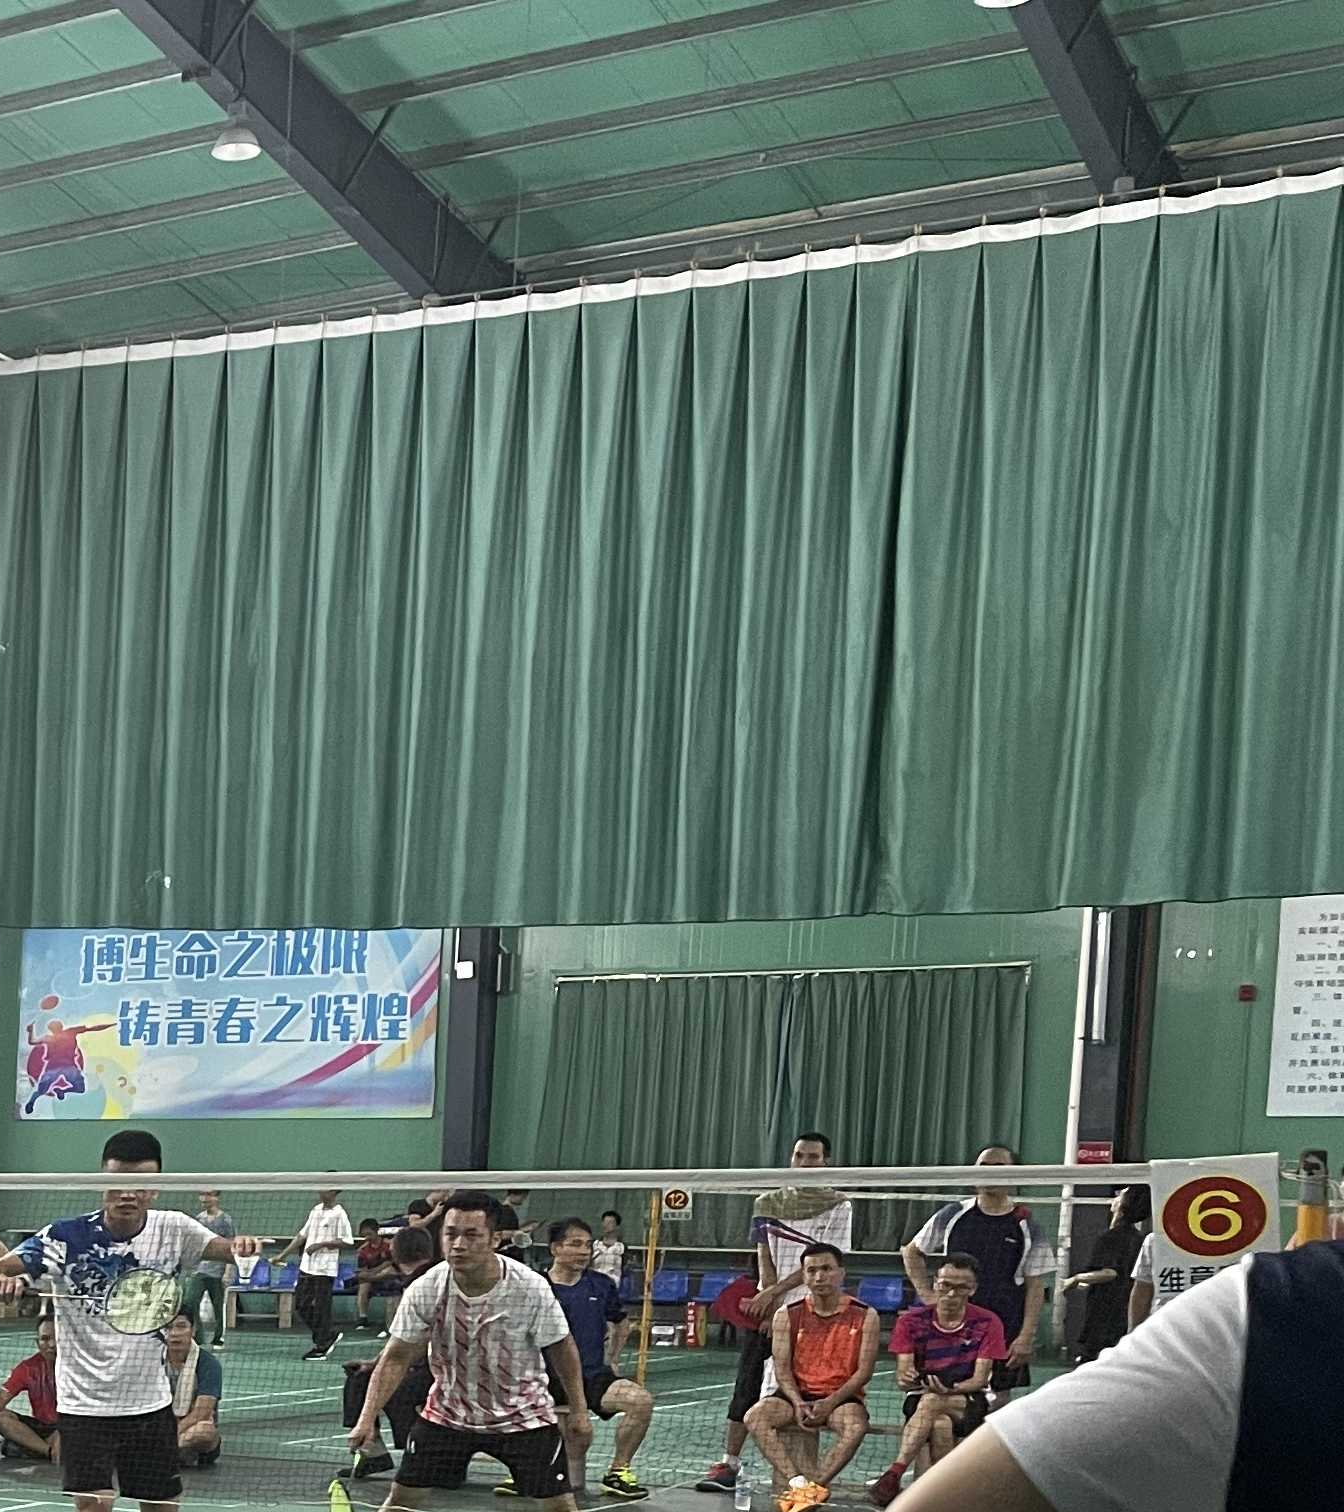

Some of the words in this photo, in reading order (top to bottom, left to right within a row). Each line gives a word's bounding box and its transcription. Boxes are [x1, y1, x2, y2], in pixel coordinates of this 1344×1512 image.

[118, 992, 409, 1047] 铸青春之辉煌
[668, 1193, 685, 1206] 12
[1188, 1190, 1242, 1242] 6
